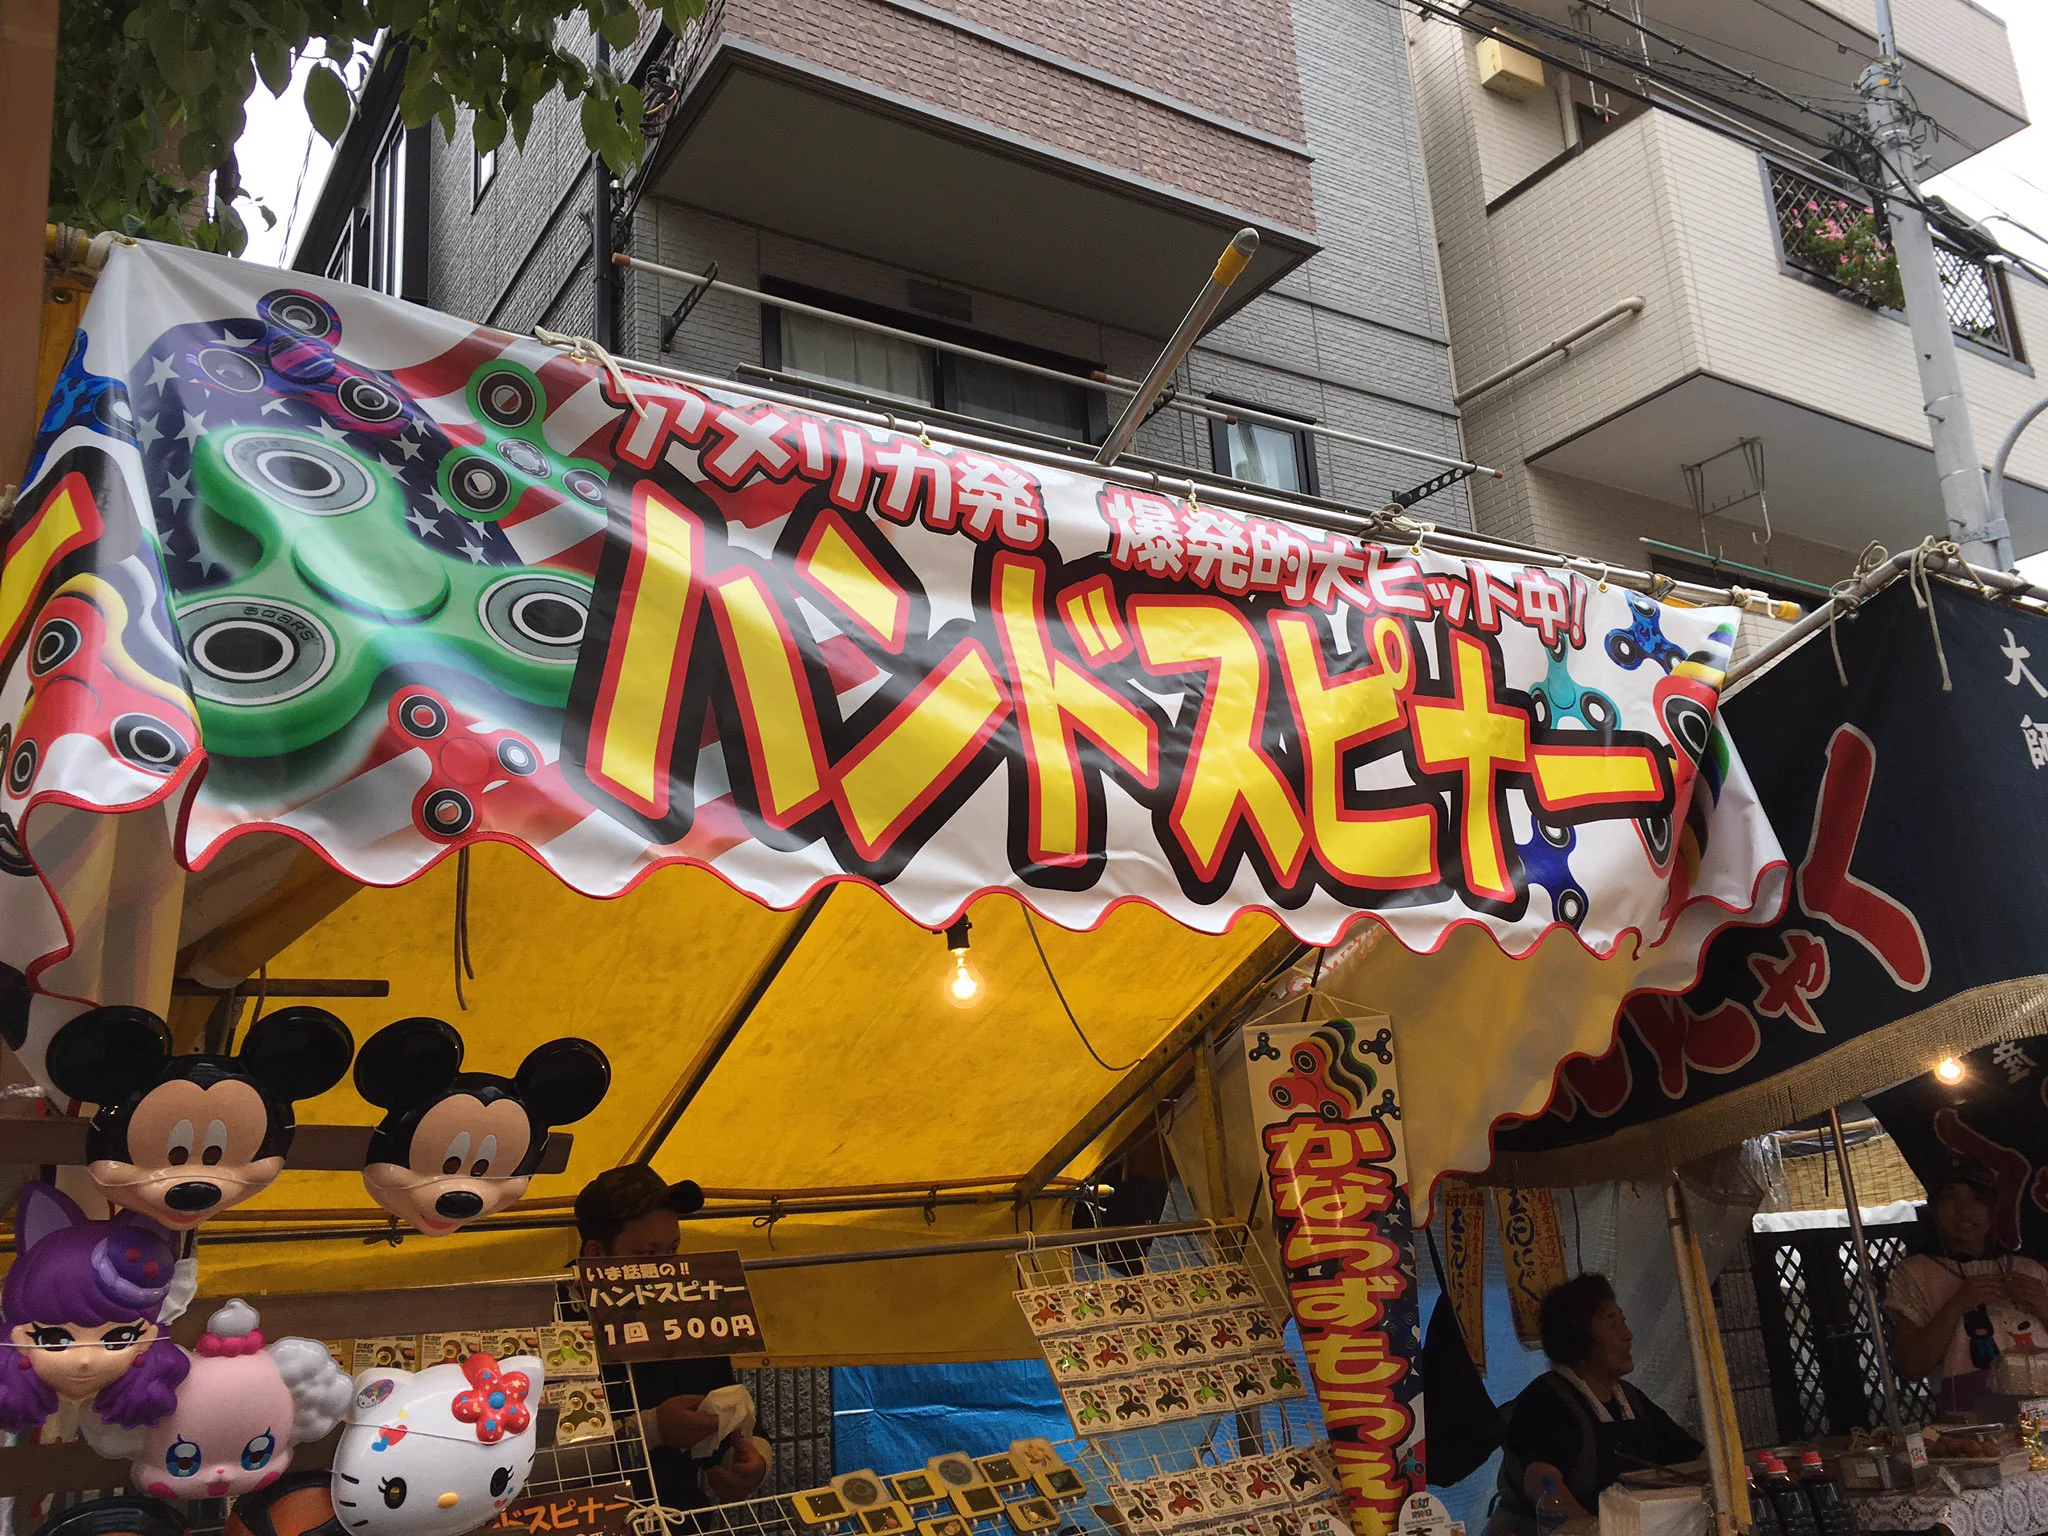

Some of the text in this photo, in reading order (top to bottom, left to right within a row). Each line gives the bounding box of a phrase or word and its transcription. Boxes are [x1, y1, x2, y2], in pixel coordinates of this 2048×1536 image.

[602, 369, 1044, 548] アメリカ発
[586, 479, 1667, 904] ハンドスピナー
[589, 1280, 746, 1308] ハンドスピナー
[604, 1314, 756, 1346] 1回 500円
[492, 1497, 630, 1534] ドスピナー
